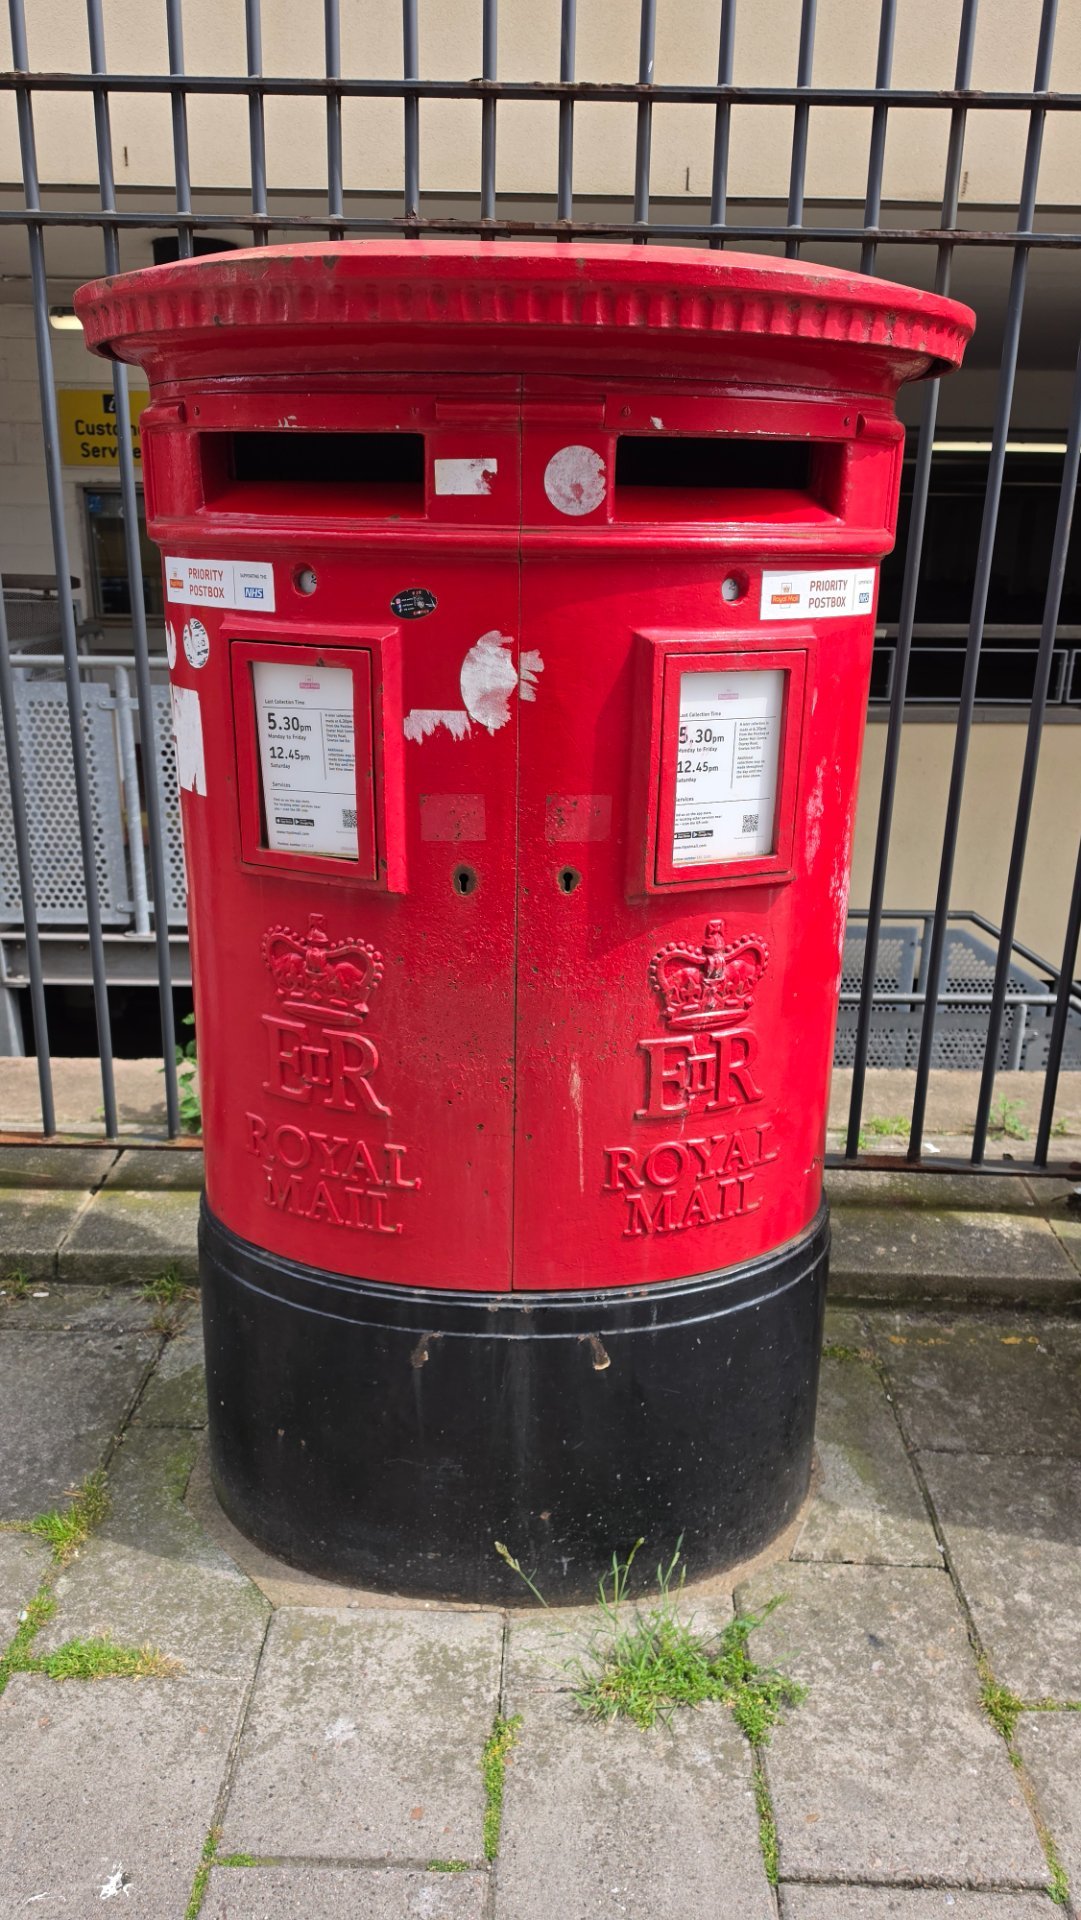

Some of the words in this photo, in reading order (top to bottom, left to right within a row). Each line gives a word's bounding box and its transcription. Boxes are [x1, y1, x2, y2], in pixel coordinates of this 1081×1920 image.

[80, 442, 142, 458] Serve
[188, 567, 224, 582] PRIORITY
[189, 584, 225, 599] POSTBOX
[245, 588, 263, 598] NHS
[809, 579, 848, 592] PRIORITY
[808, 596, 846, 609] POSTBOX
[267, 712, 312, 732] 5.30pm
[678, 726, 725, 744] 5.30pm
[269, 746, 311, 761] 12.45pm
[676, 760, 719, 774] 12.45pm
[245, 1112, 421, 1189] ROYAL
[602, 1122, 779, 1191] ROYAL
[262, 1164, 403, 1235] MAIL
[623, 1173, 764, 1239] MAIL
